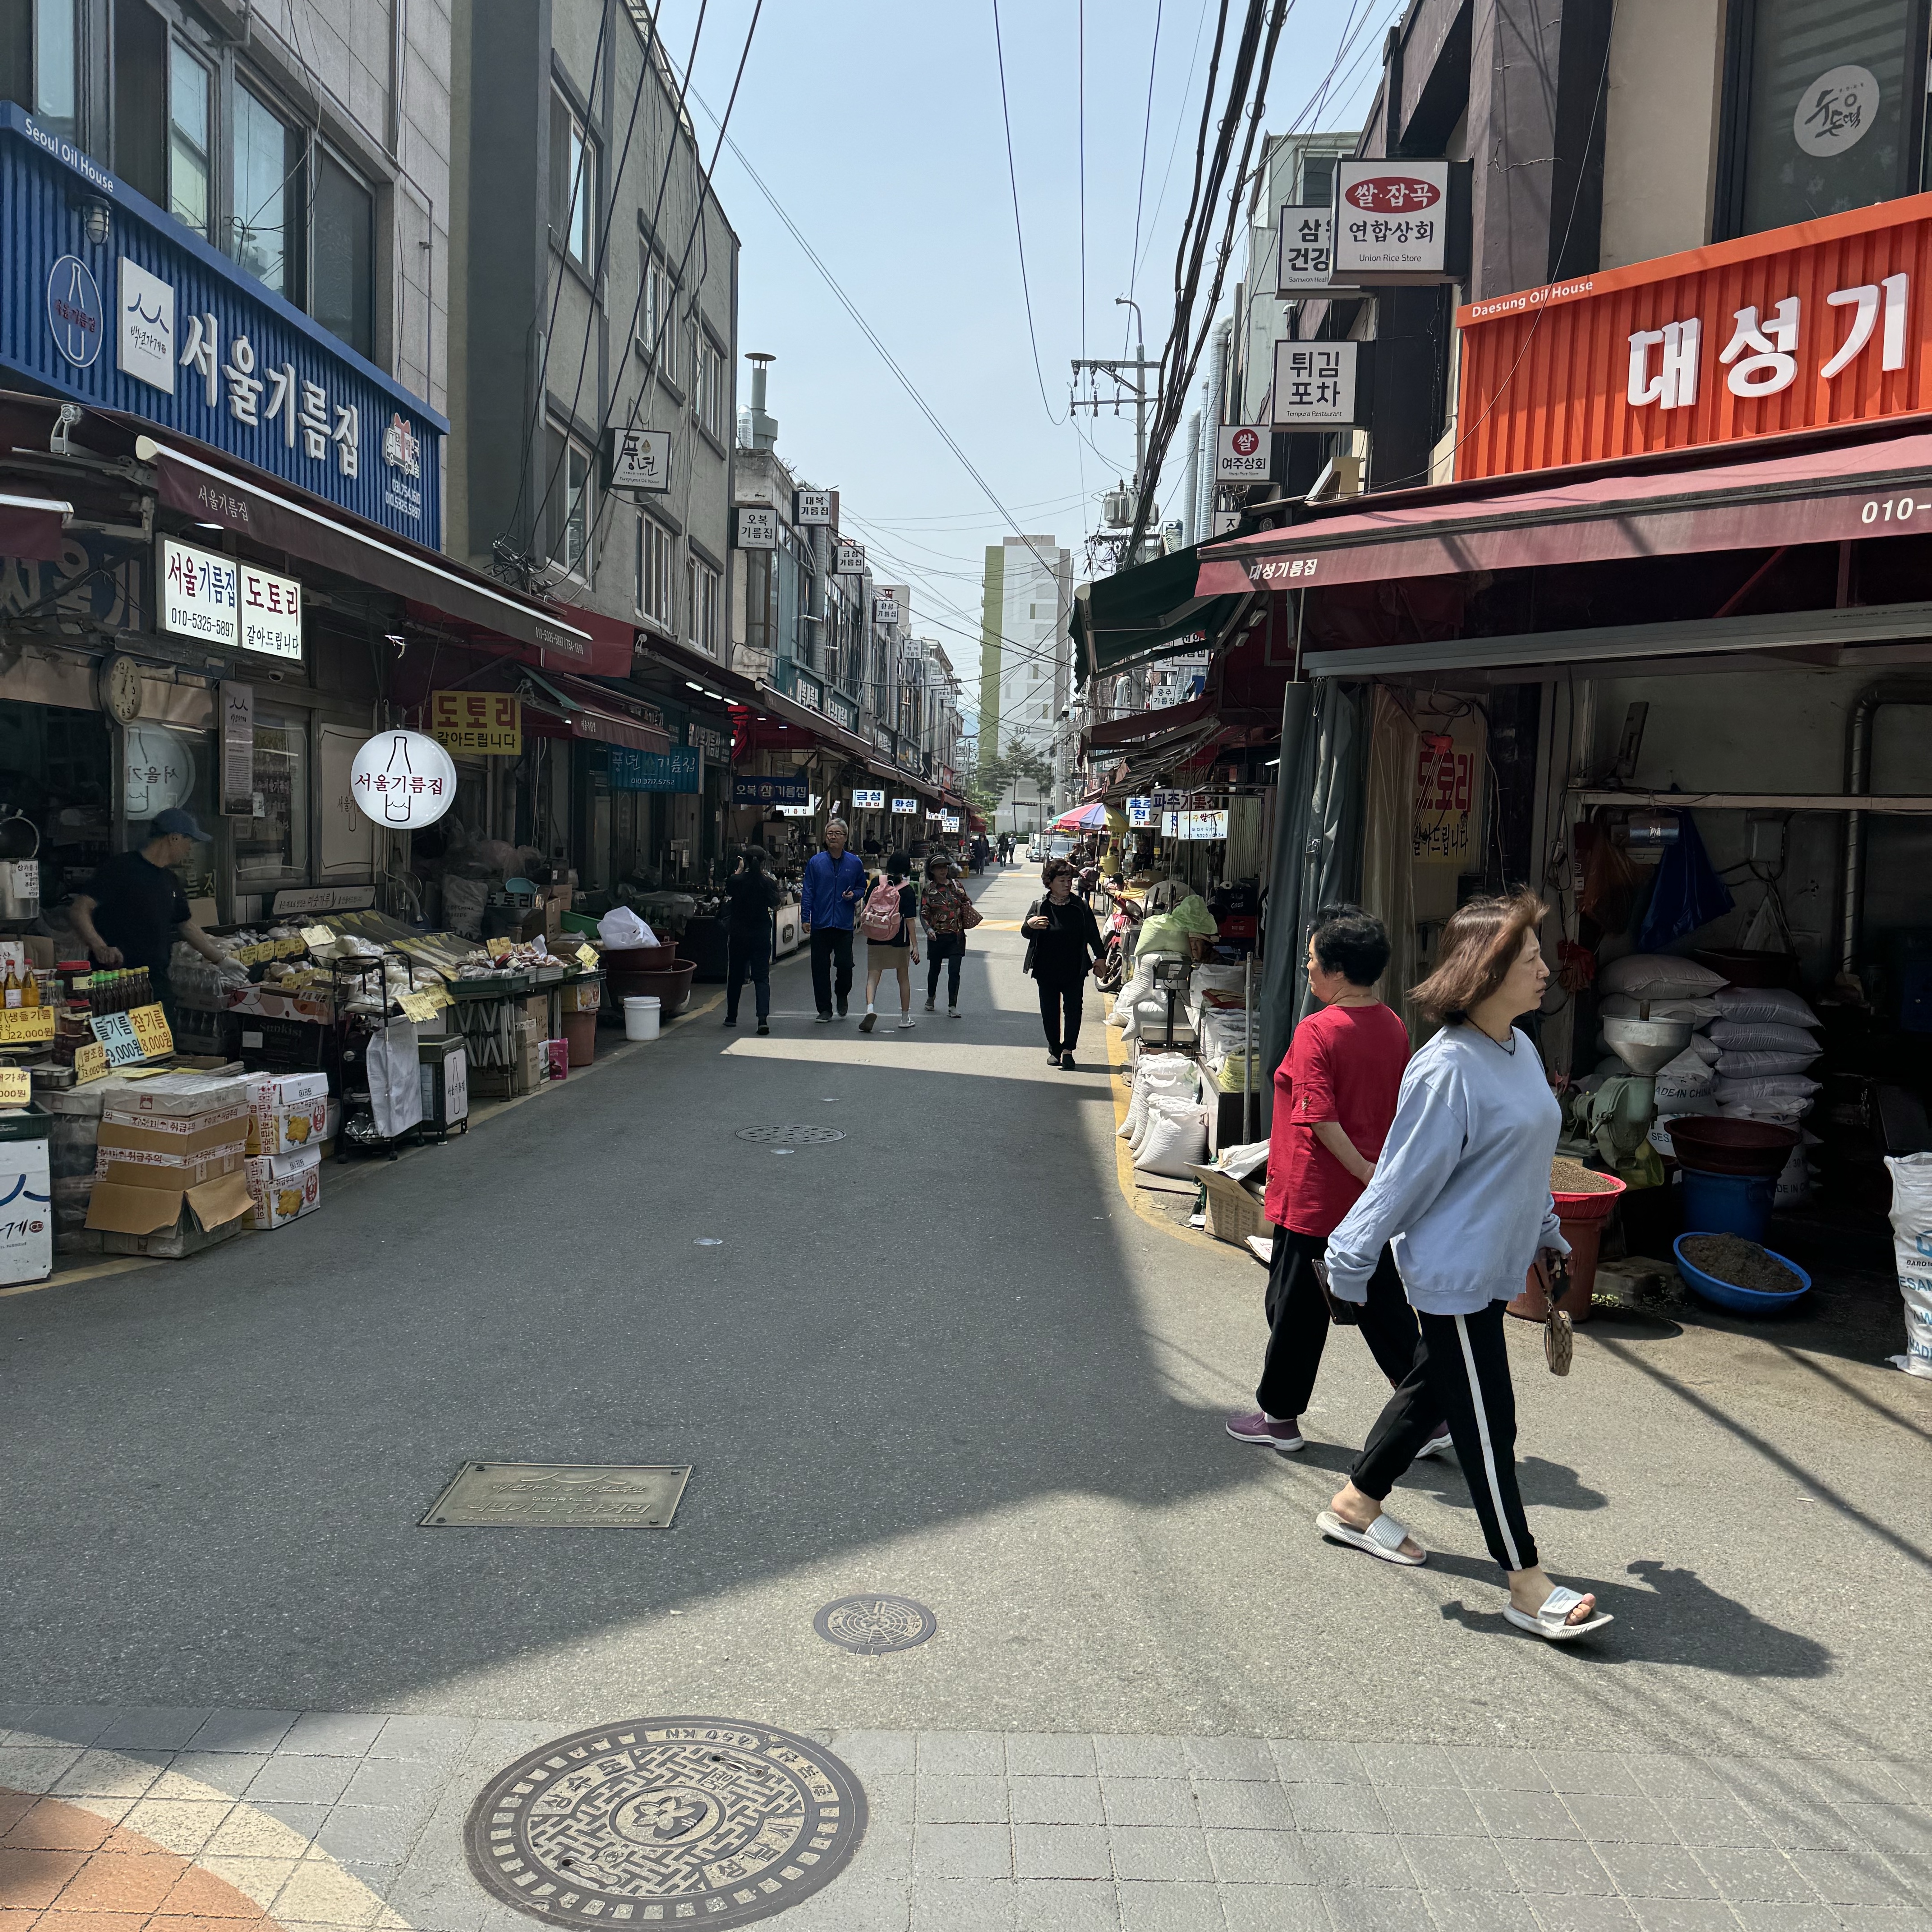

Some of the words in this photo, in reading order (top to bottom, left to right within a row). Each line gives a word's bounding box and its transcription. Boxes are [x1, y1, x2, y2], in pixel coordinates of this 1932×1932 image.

[25, 119, 59, 156] Seoul
[60, 143, 78, 169] Oil
[80, 156, 114, 193] House
[1349, 220, 1434, 243] 연합상회
[1471, 295, 1527, 318] Daesung
[1529, 288, 1549, 303] Oil
[1552, 279, 1593, 299] House
[1628, 272, 1909, 410] 대성기
[1289, 351, 1339, 378] 튀김
[179, 312, 359, 480] 서울기름집
[1288, 381, 1341, 407] 포차
[1237, 432, 1255, 451] 쌀
[1222, 457, 1266, 470] 여주상회
[198, 485, 248, 522] 서울기름집
[747, 514, 768, 526] 오복
[741, 527, 773, 539] 기름집
[168, 552, 235, 608] 서울기름집
[1248, 558, 1318, 580] 대성기름집
[245, 575, 299, 627] 도토리
[171, 607, 235, 638] 010-5325-5897
[246, 625, 299, 656] 갈아드립니다
[437, 695, 516, 731] 도토리
[437, 731, 516, 749] 갈아드립니다
[612, 751, 641, 773] 풍년
[657, 755, 696, 773] 기름집
[354, 772, 443, 796] 서울기름집
[857, 791, 881, 800] 금성
[895, 800, 914, 808] 화성
[95, 1015, 133, 1041] 들기름
[131, 1009, 165, 1033] 참기름
[259, 1022, 302, 1037] Sunkist
[10, 1027, 55, 1040] 22,000원
[142, 1030, 173, 1053] 8,000원
[665, 1729, 696, 1739] KN
[541, 1757, 629, 1809] 상수도
[715, 1822, 800, 1880] 성남시
